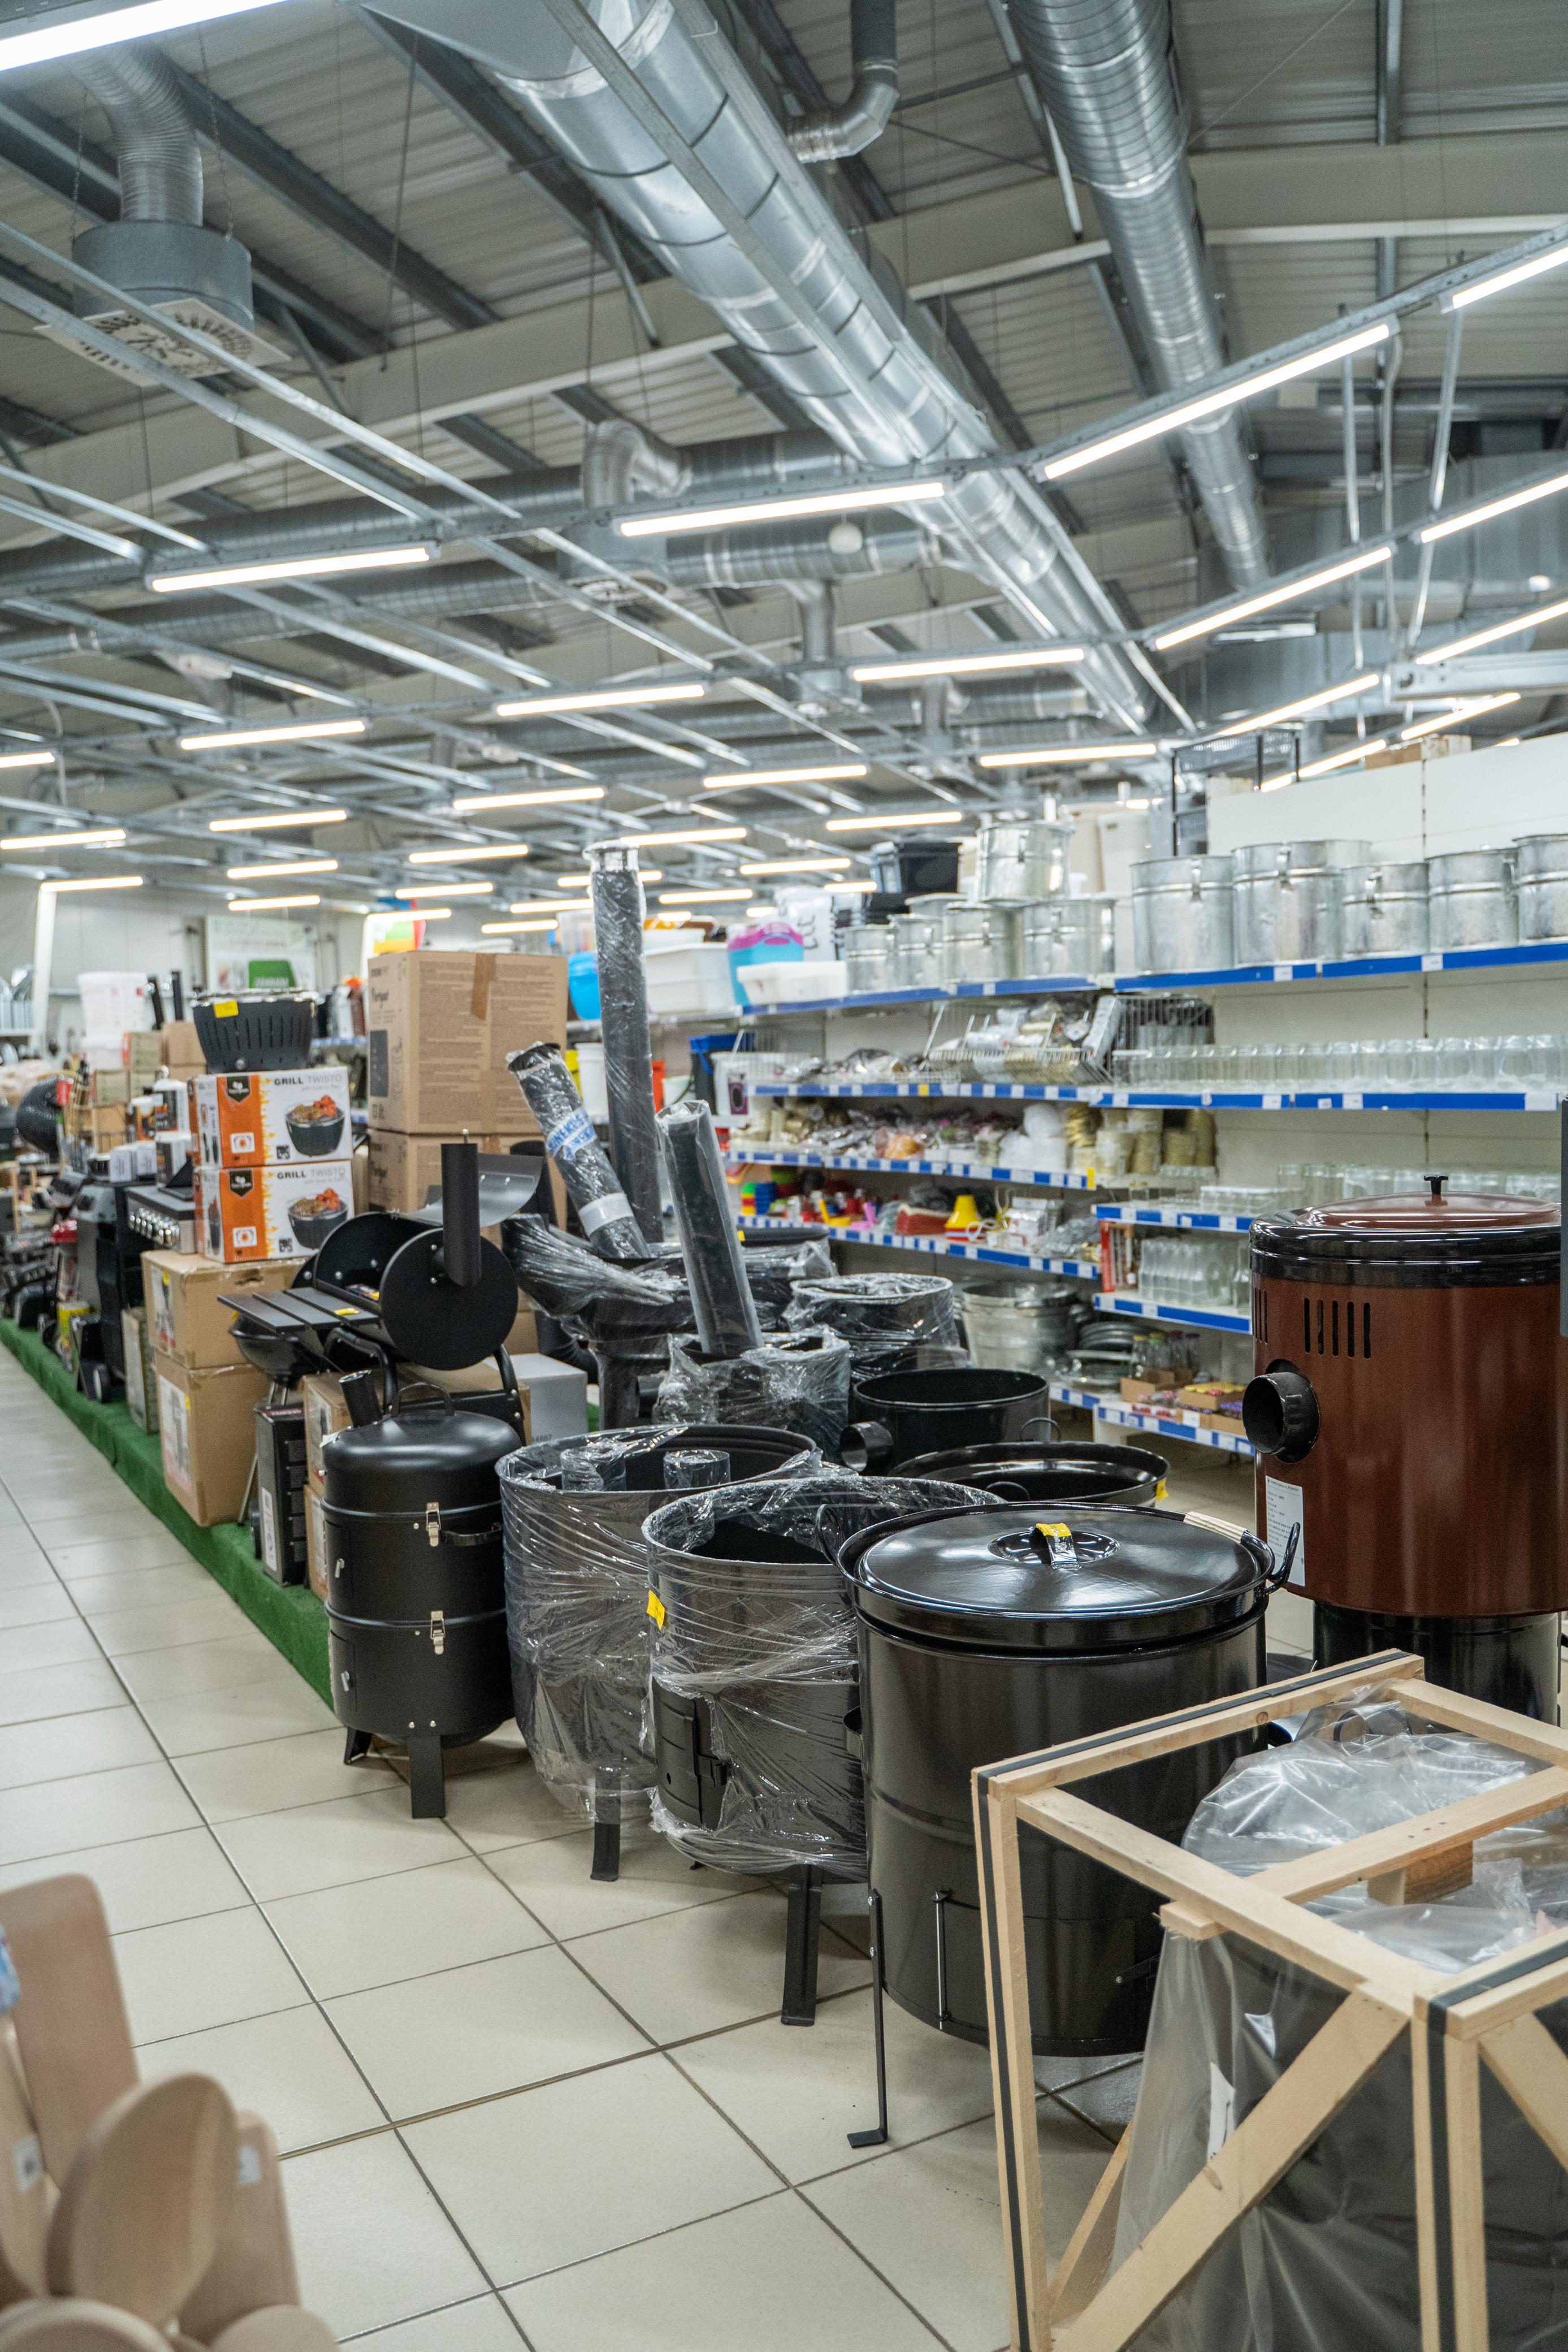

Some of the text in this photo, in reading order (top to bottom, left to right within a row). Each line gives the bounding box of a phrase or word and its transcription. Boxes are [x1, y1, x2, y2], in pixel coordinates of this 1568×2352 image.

[274, 1074, 343, 1086] GRILL TWISTO
[277, 1167, 345, 1179] GRILL TWISTO
